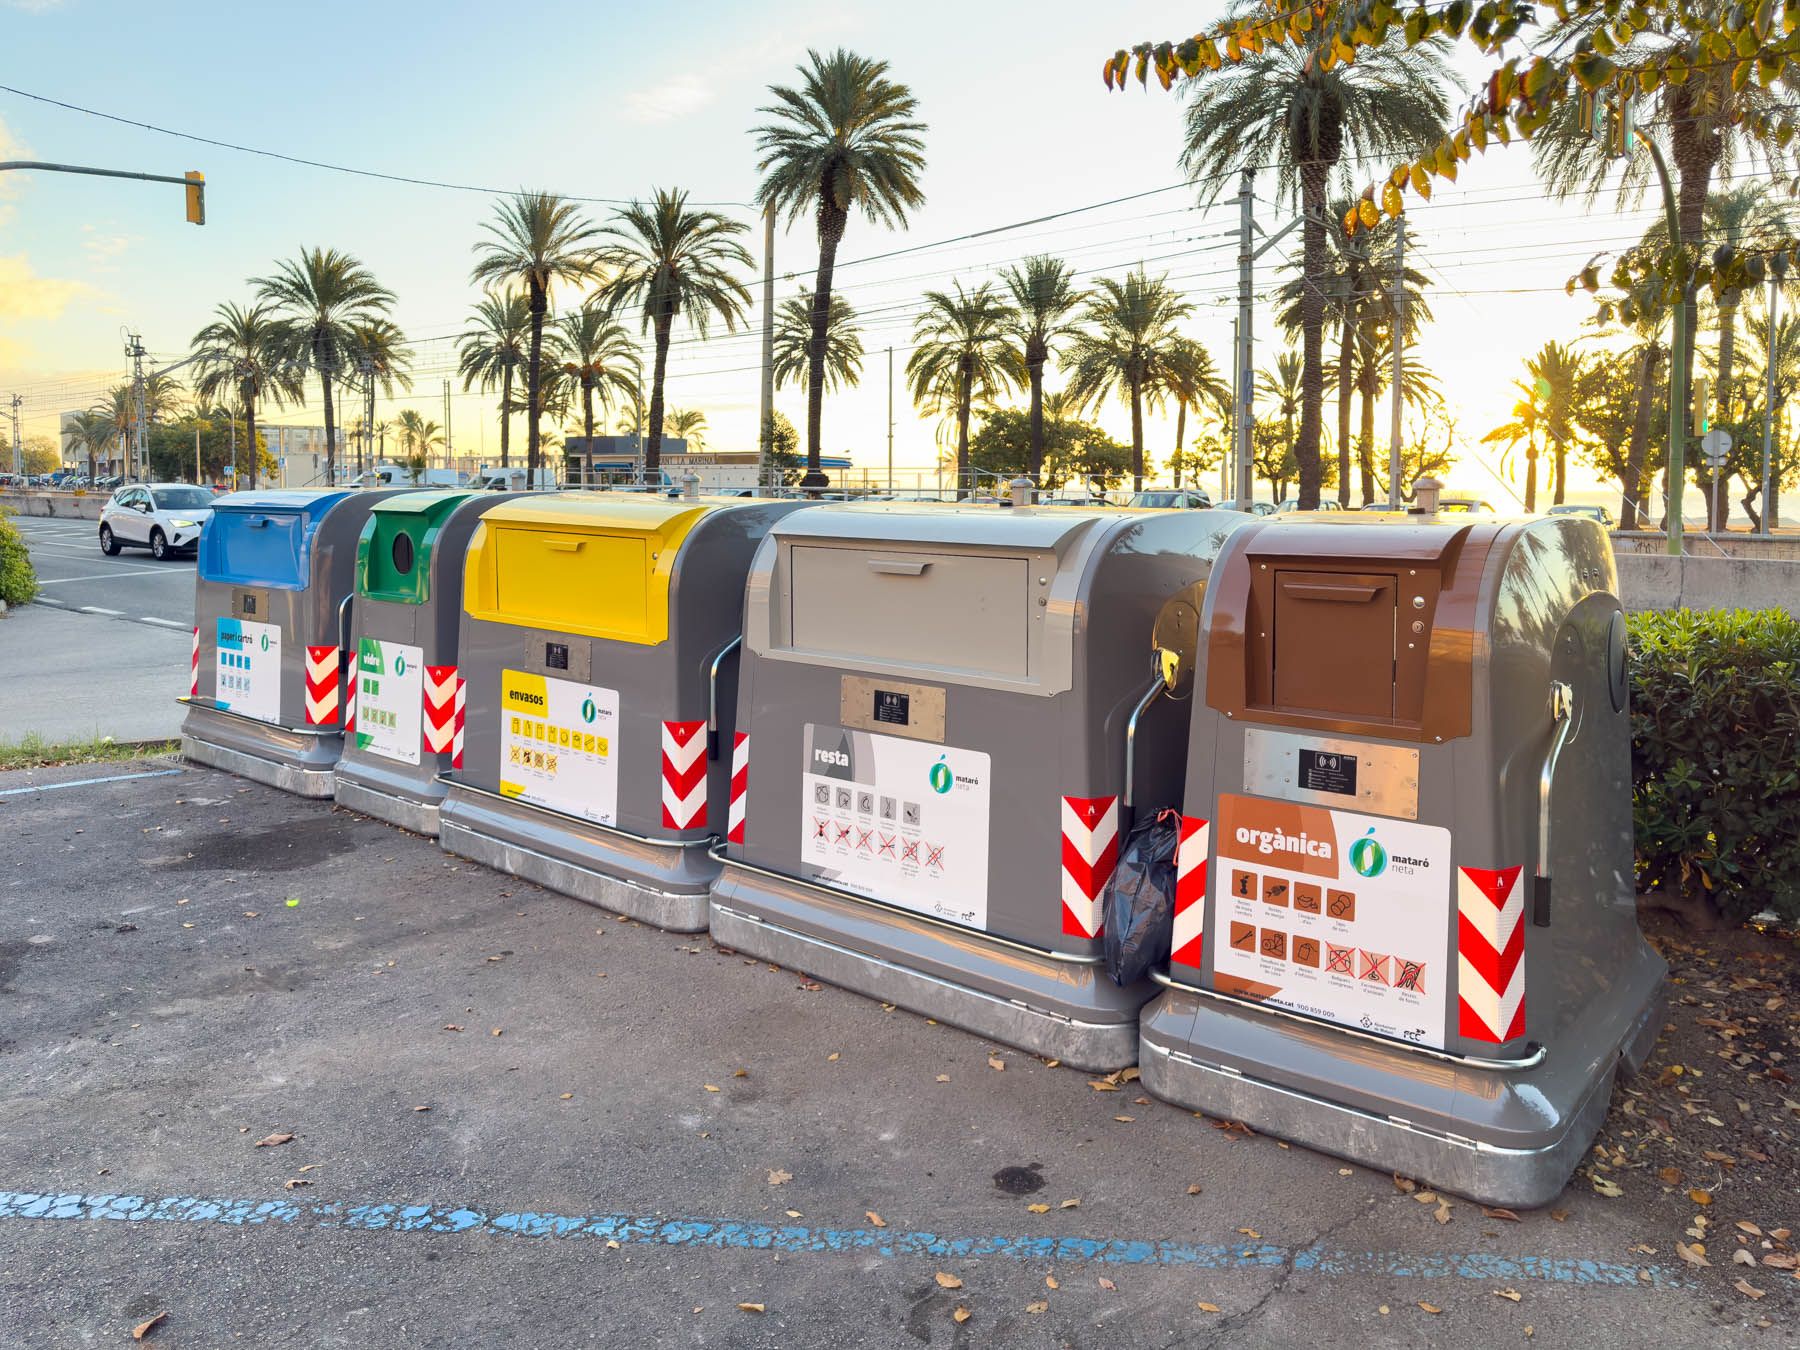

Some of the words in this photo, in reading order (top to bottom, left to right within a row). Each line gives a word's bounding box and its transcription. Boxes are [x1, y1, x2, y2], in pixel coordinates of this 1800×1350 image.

[688, 456, 715, 465] MARINA
[363, 653, 380, 666] vidre
[509, 689, 544, 706] envasos
[815, 749, 849, 767] resta
[955, 775, 979, 785] mataró
[1236, 827, 1332, 860] orgànica
[1392, 855, 1429, 868] mataró
[1392, 865, 1414, 875] neta
[1296, 1003, 1309, 1011] 900
